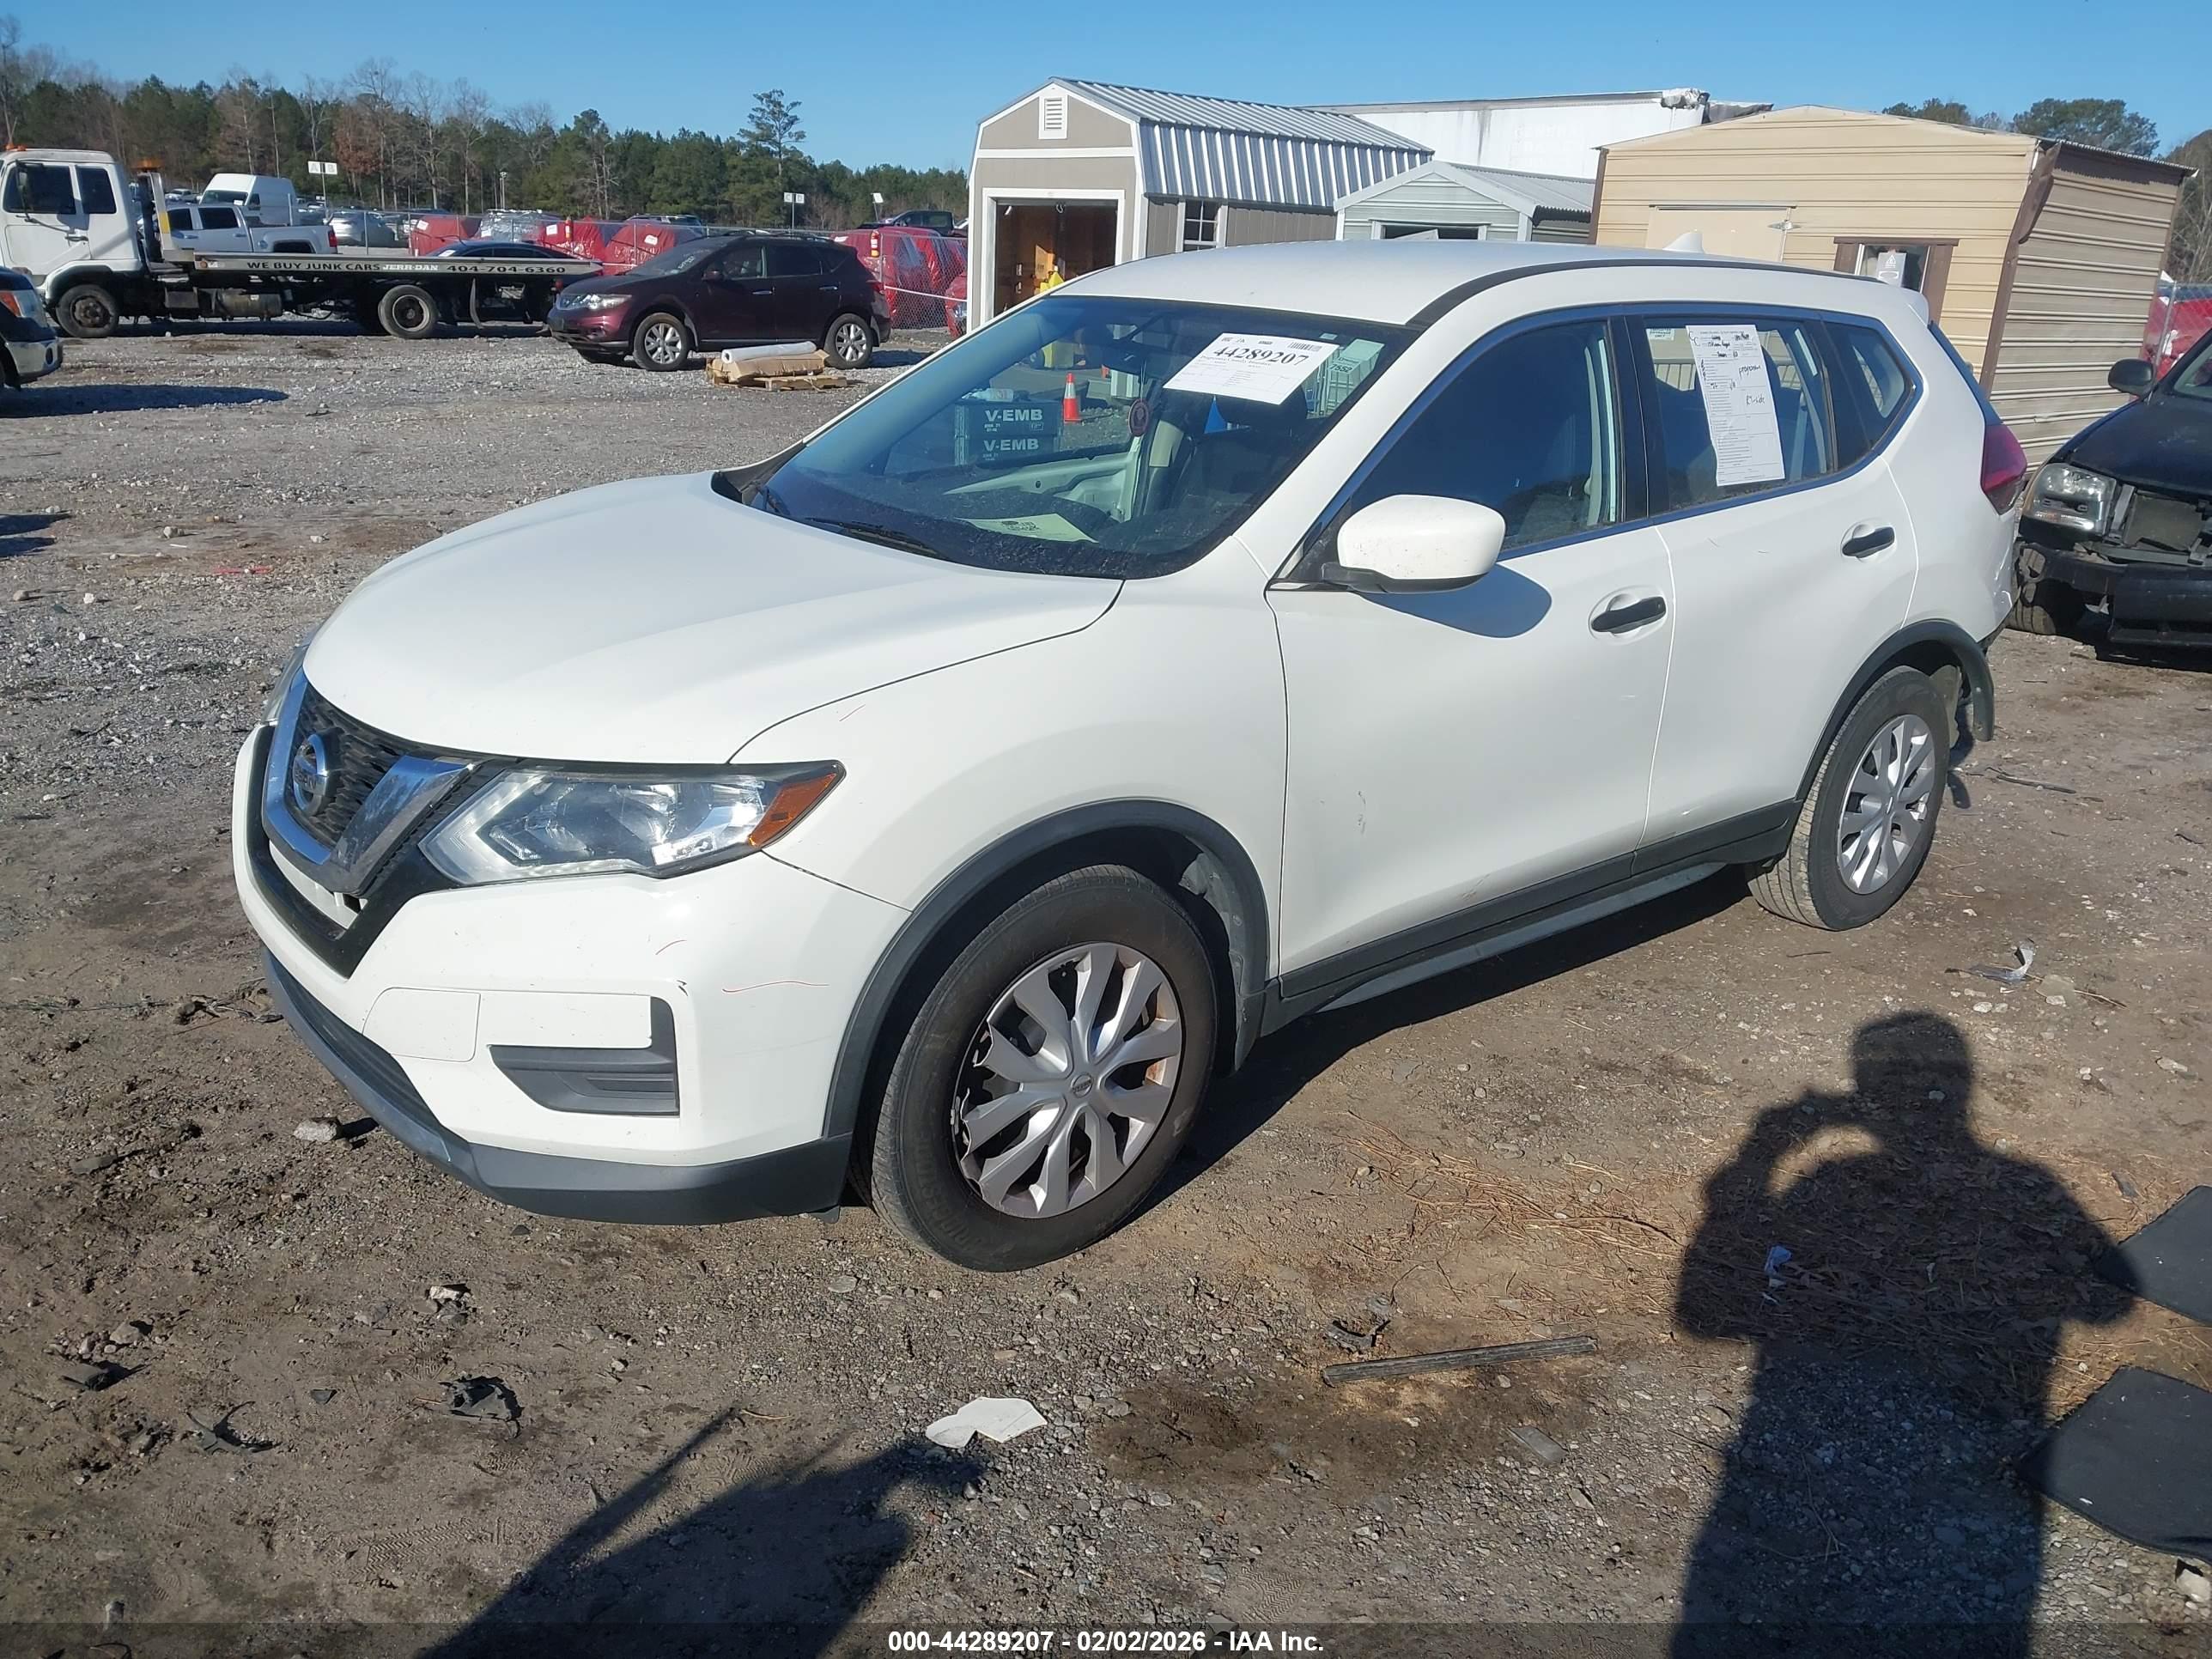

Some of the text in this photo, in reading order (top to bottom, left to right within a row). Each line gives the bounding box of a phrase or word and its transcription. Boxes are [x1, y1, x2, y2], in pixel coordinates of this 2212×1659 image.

[1213, 346, 1310, 366] 44289207
[984, 409, 1043, 422] V-EMB
[983, 438, 1039, 452] V-EMB
